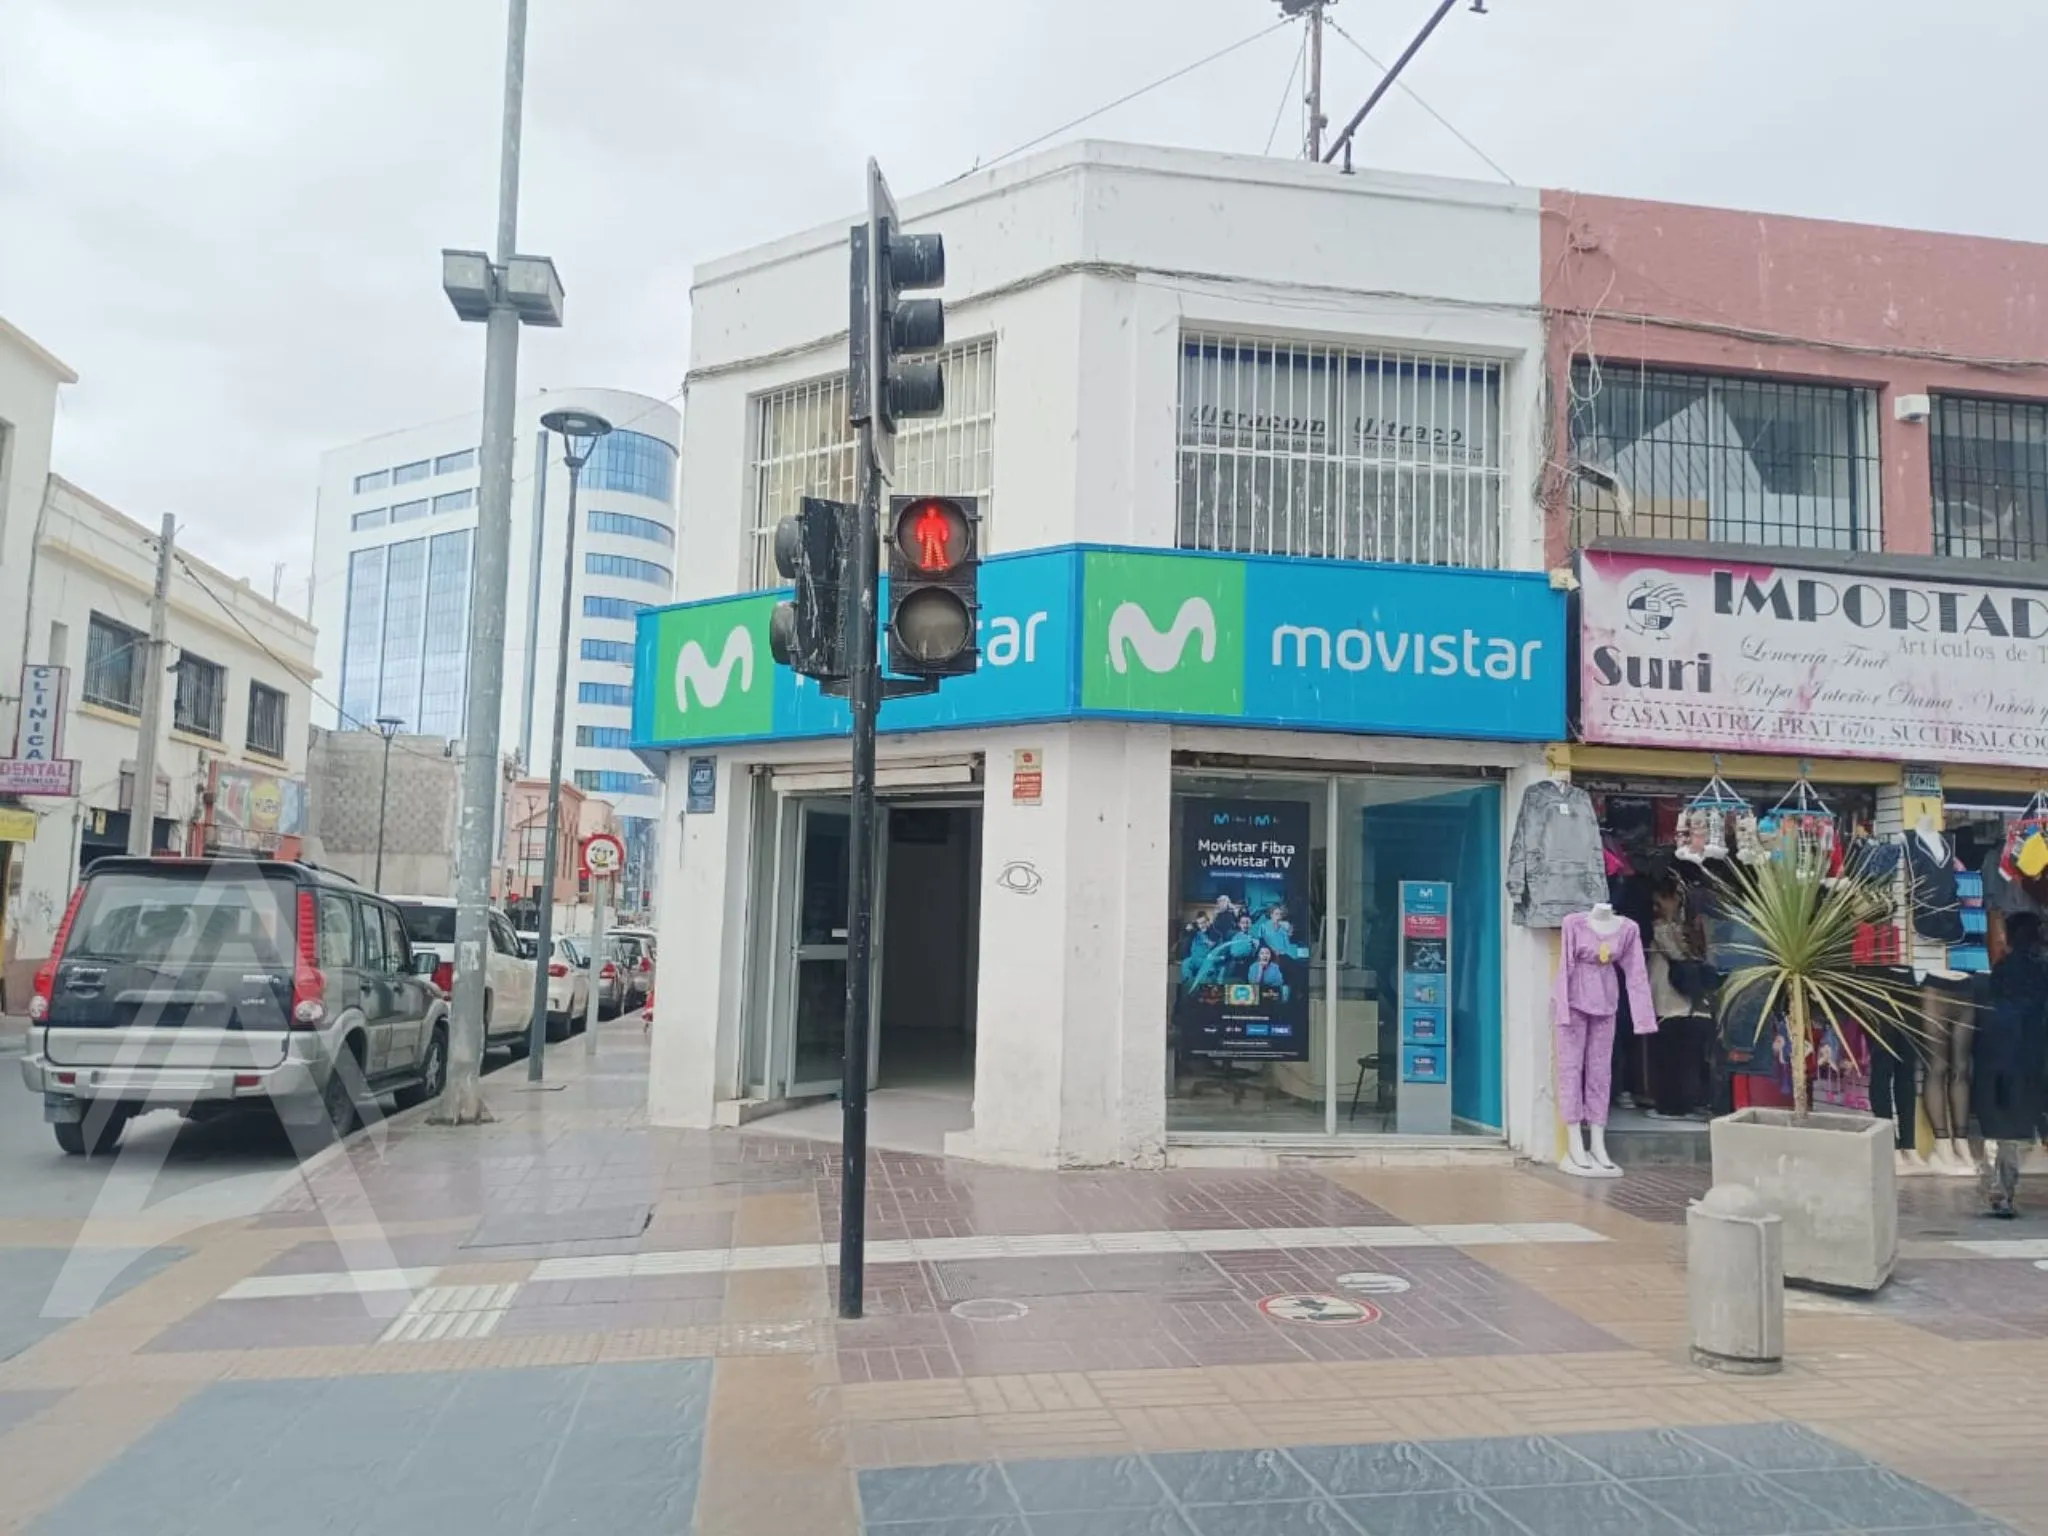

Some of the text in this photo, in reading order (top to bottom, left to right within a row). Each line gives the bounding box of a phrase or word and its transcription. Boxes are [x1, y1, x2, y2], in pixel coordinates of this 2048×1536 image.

[1714, 571, 2048, 640] IMPORTAD
[1271, 624, 1543, 681] movistar
[1593, 644, 1712, 693] Suri
[2006, 642, 2029, 662] de
[1734, 671, 1794, 706] Ropa
[25, 666, 51, 760] CLINICA
[1609, 703, 1669, 726] CASA
[1891, 724, 2005, 749] SUCURSAL
[0, 761, 67, 777] DENTAL
[1197, 838, 1296, 855] Movistar Fibra
[1208, 853, 1269, 868] Movistar
[1272, 856, 1292, 869] TV
